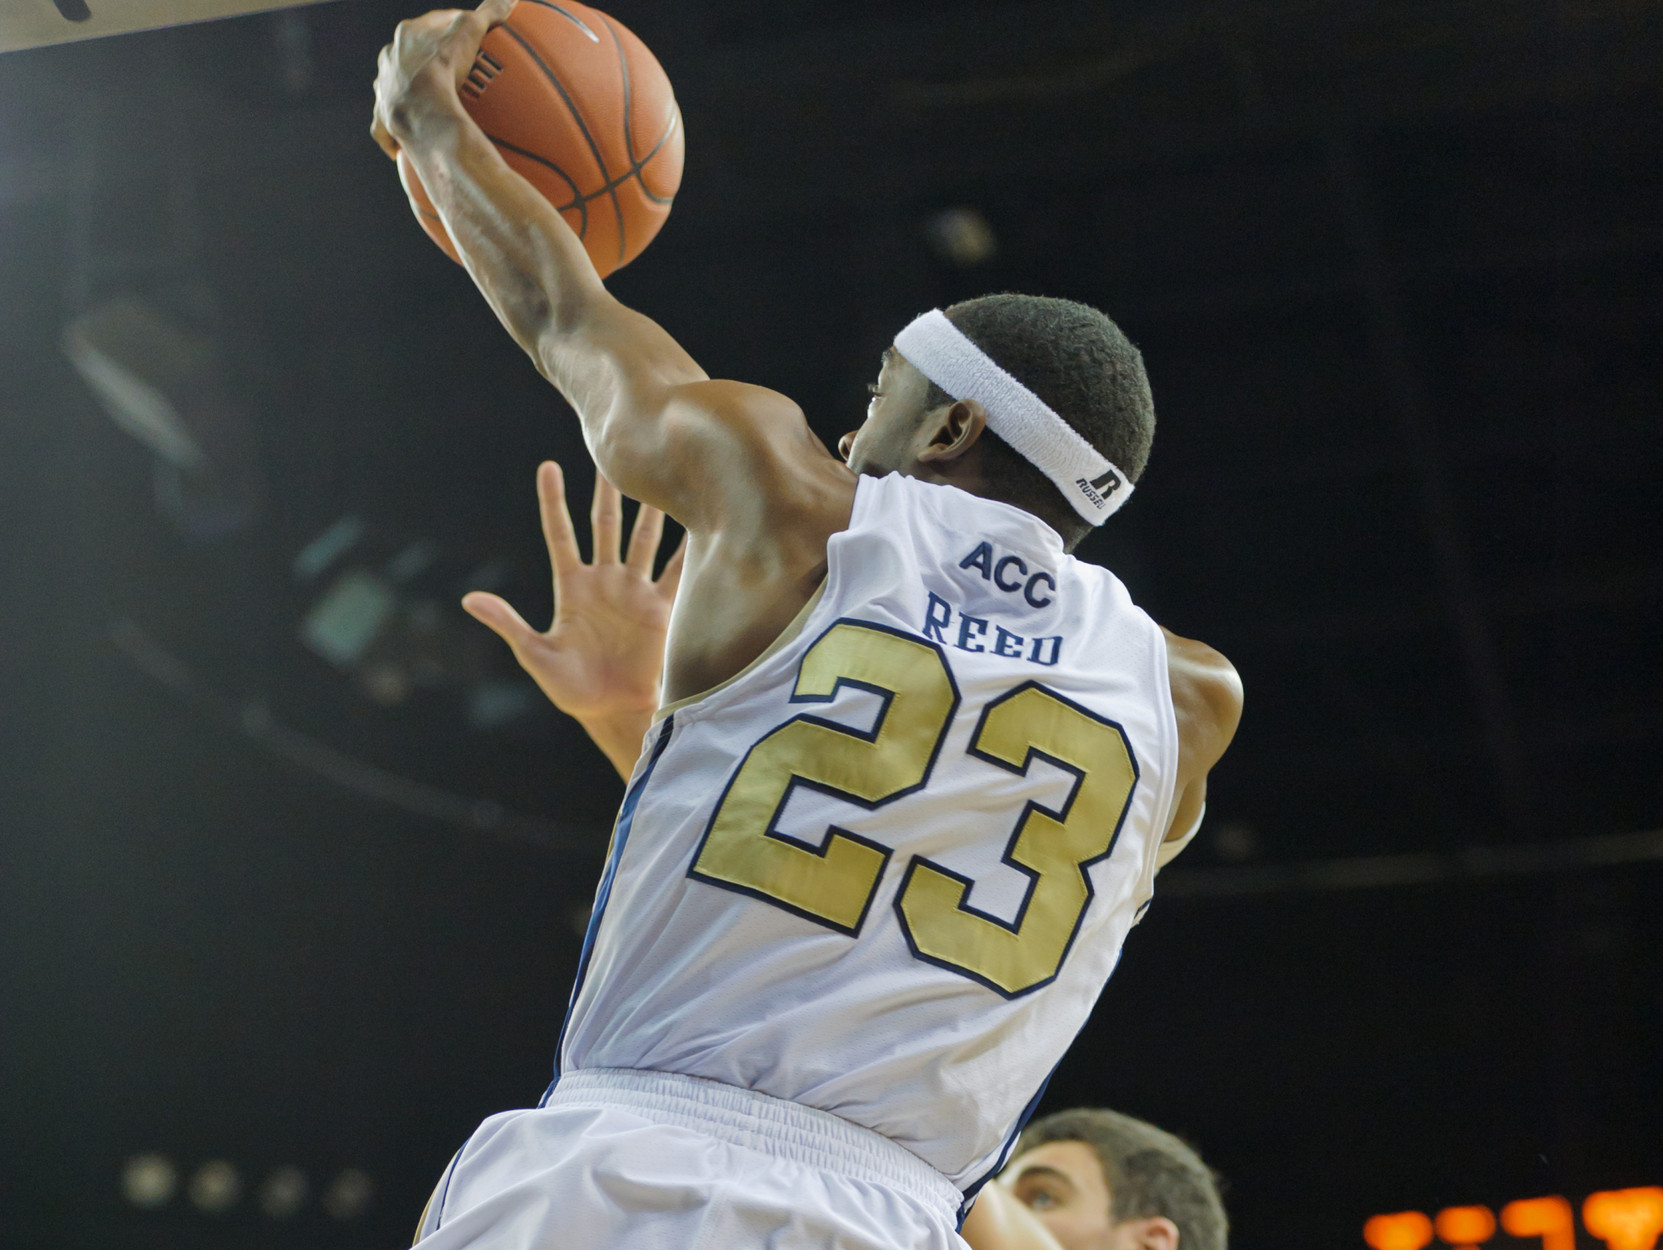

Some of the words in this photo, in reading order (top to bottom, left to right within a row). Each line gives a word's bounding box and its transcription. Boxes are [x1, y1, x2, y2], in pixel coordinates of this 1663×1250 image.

[959, 541, 1056, 609] ACC
[922, 591, 1063, 666] REED
[686, 617, 1140, 1000] 23
